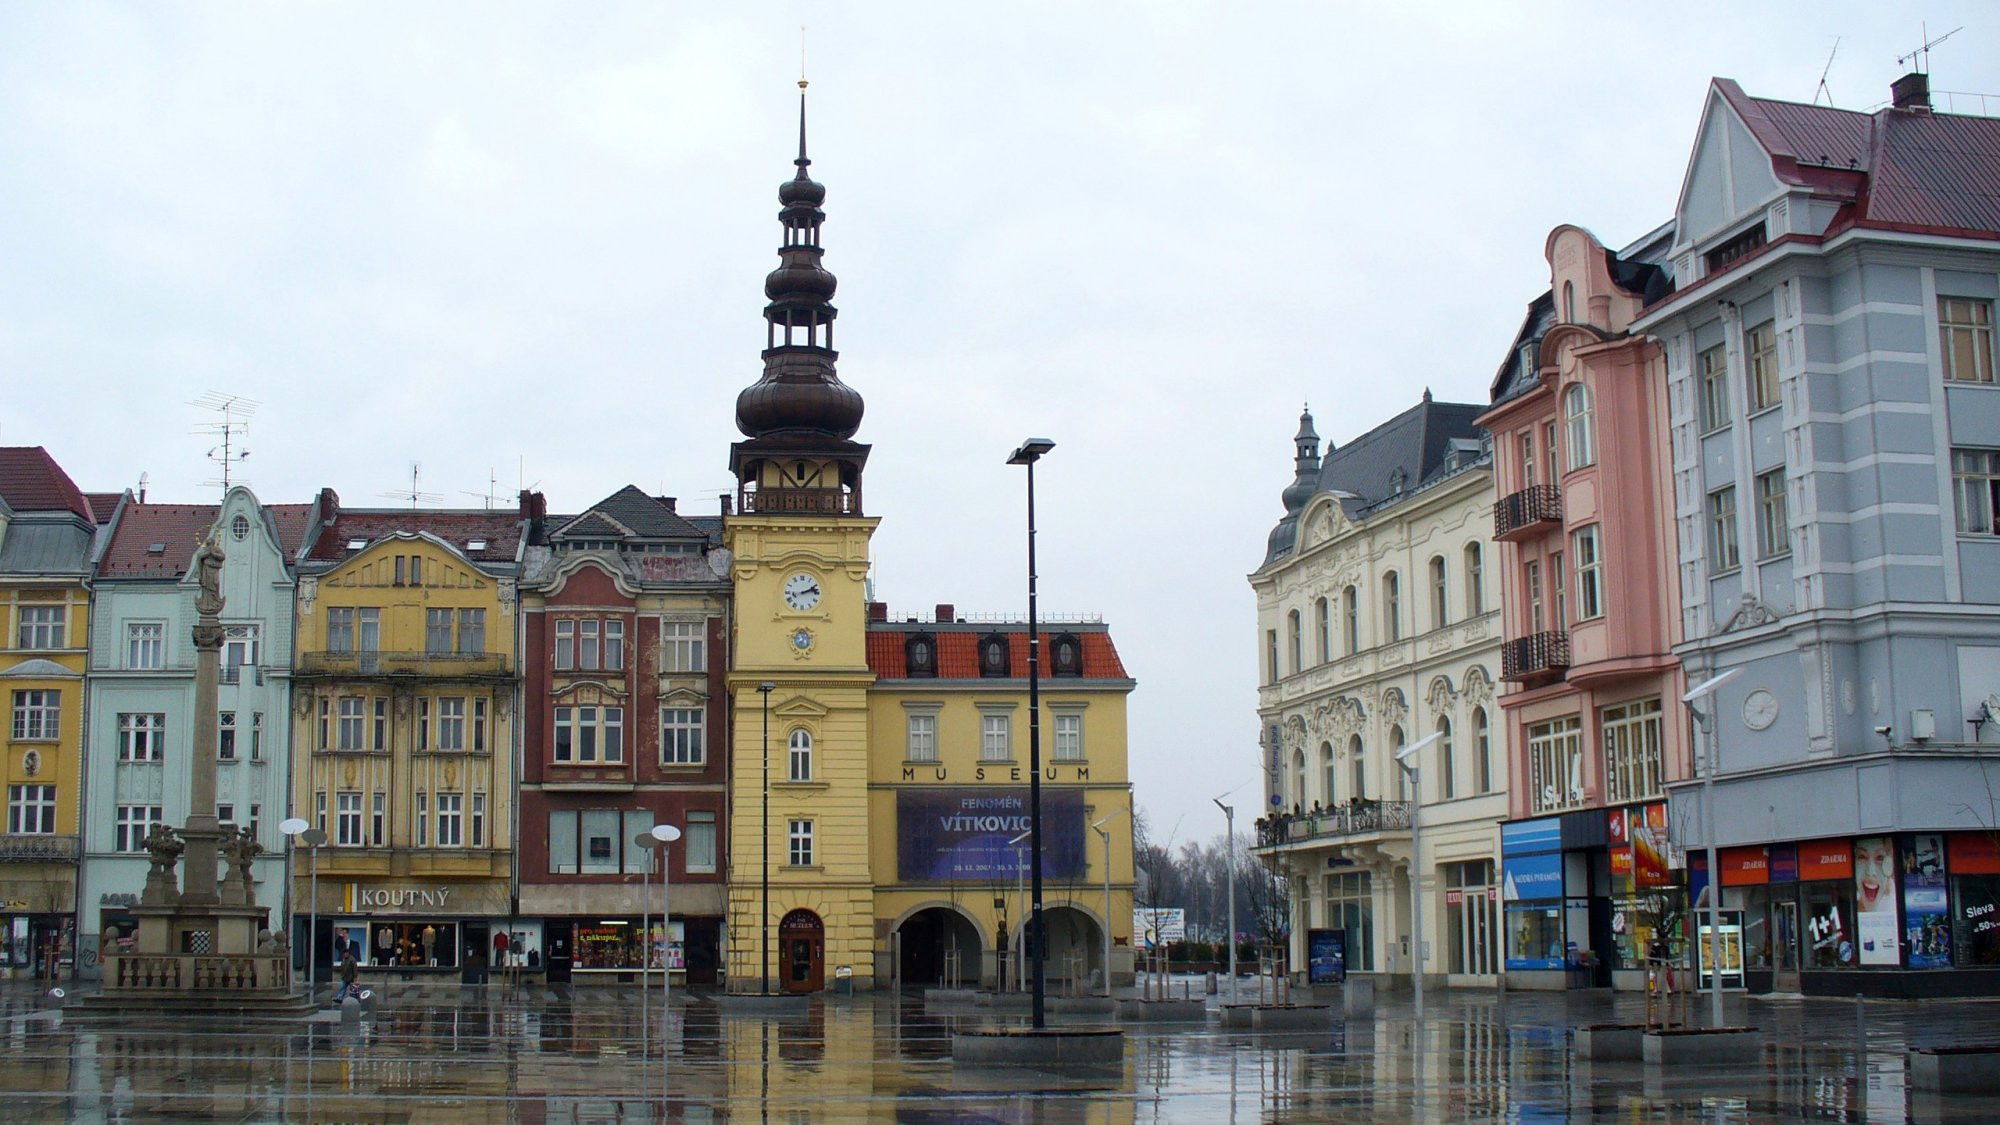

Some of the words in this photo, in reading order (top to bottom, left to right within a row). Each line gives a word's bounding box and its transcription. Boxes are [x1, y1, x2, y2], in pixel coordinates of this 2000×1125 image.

[1270, 725, 1278, 744] Bank
[1271, 745, 1280, 771] Money
[903, 767, 1090, 781] MUSEUM
[961, 795, 1022, 809] FENOMÉN
[940, 811, 1042, 832] VÍTKOVIC
[361, 886, 450, 907] KOUTNÝ
[1966, 903, 1995, 918] Sleva
[1808, 906, 1841, 942] 1+1
